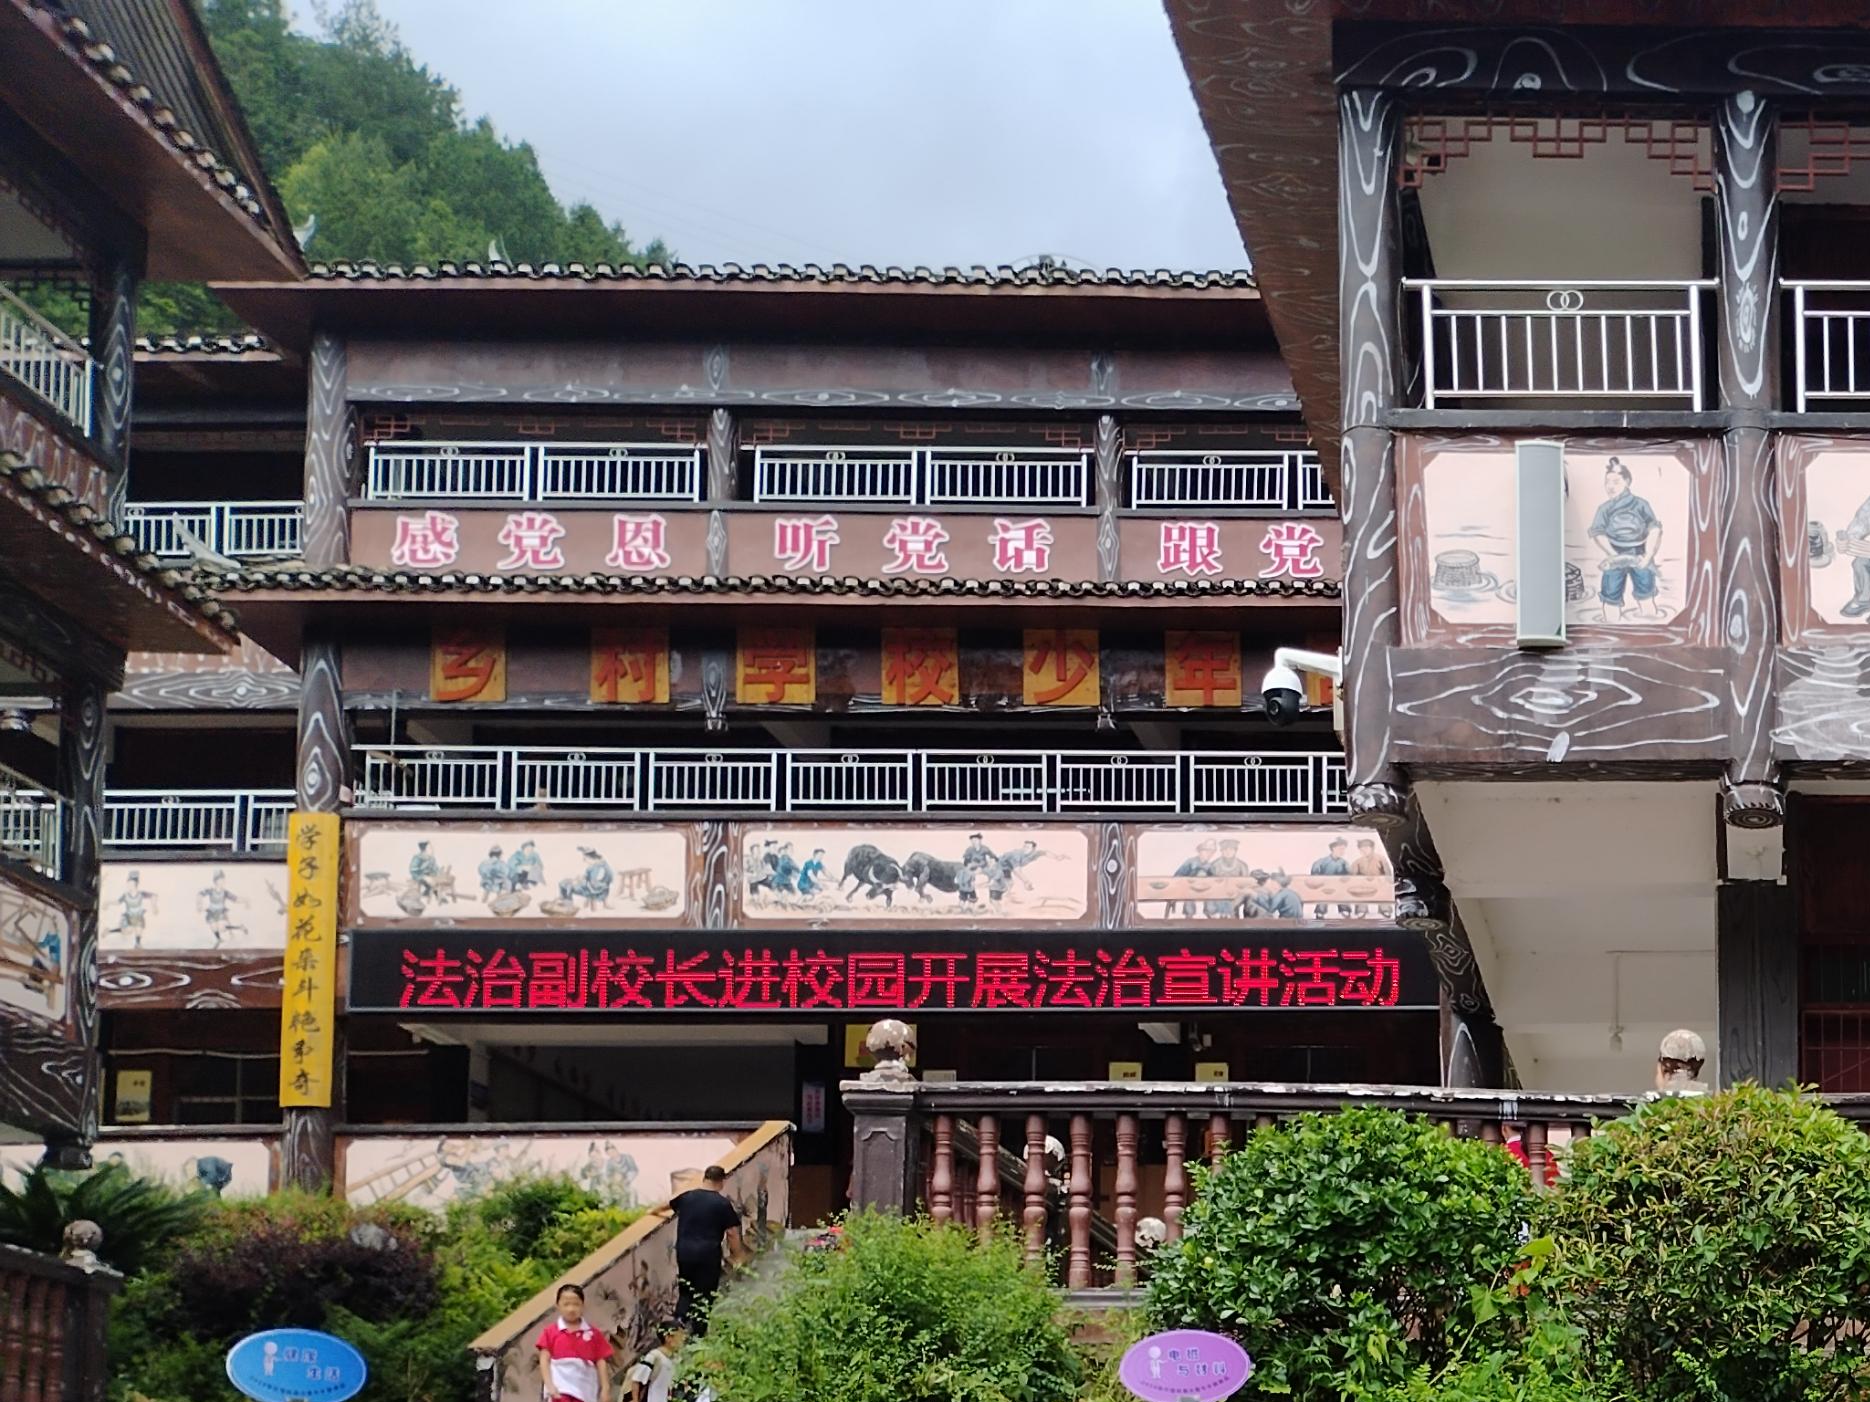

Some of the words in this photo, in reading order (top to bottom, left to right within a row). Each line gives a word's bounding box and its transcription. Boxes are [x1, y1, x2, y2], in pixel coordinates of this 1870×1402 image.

[391, 511, 671, 571] 感党恩
[774, 515, 1054, 574] 听党话
[1158, 522, 1324, 577] 跟党
[434, 627, 1335, 706] 乡村学校少年
[399, 948, 1401, 1008] 法治副校长进校园开展法治宣讲活动
